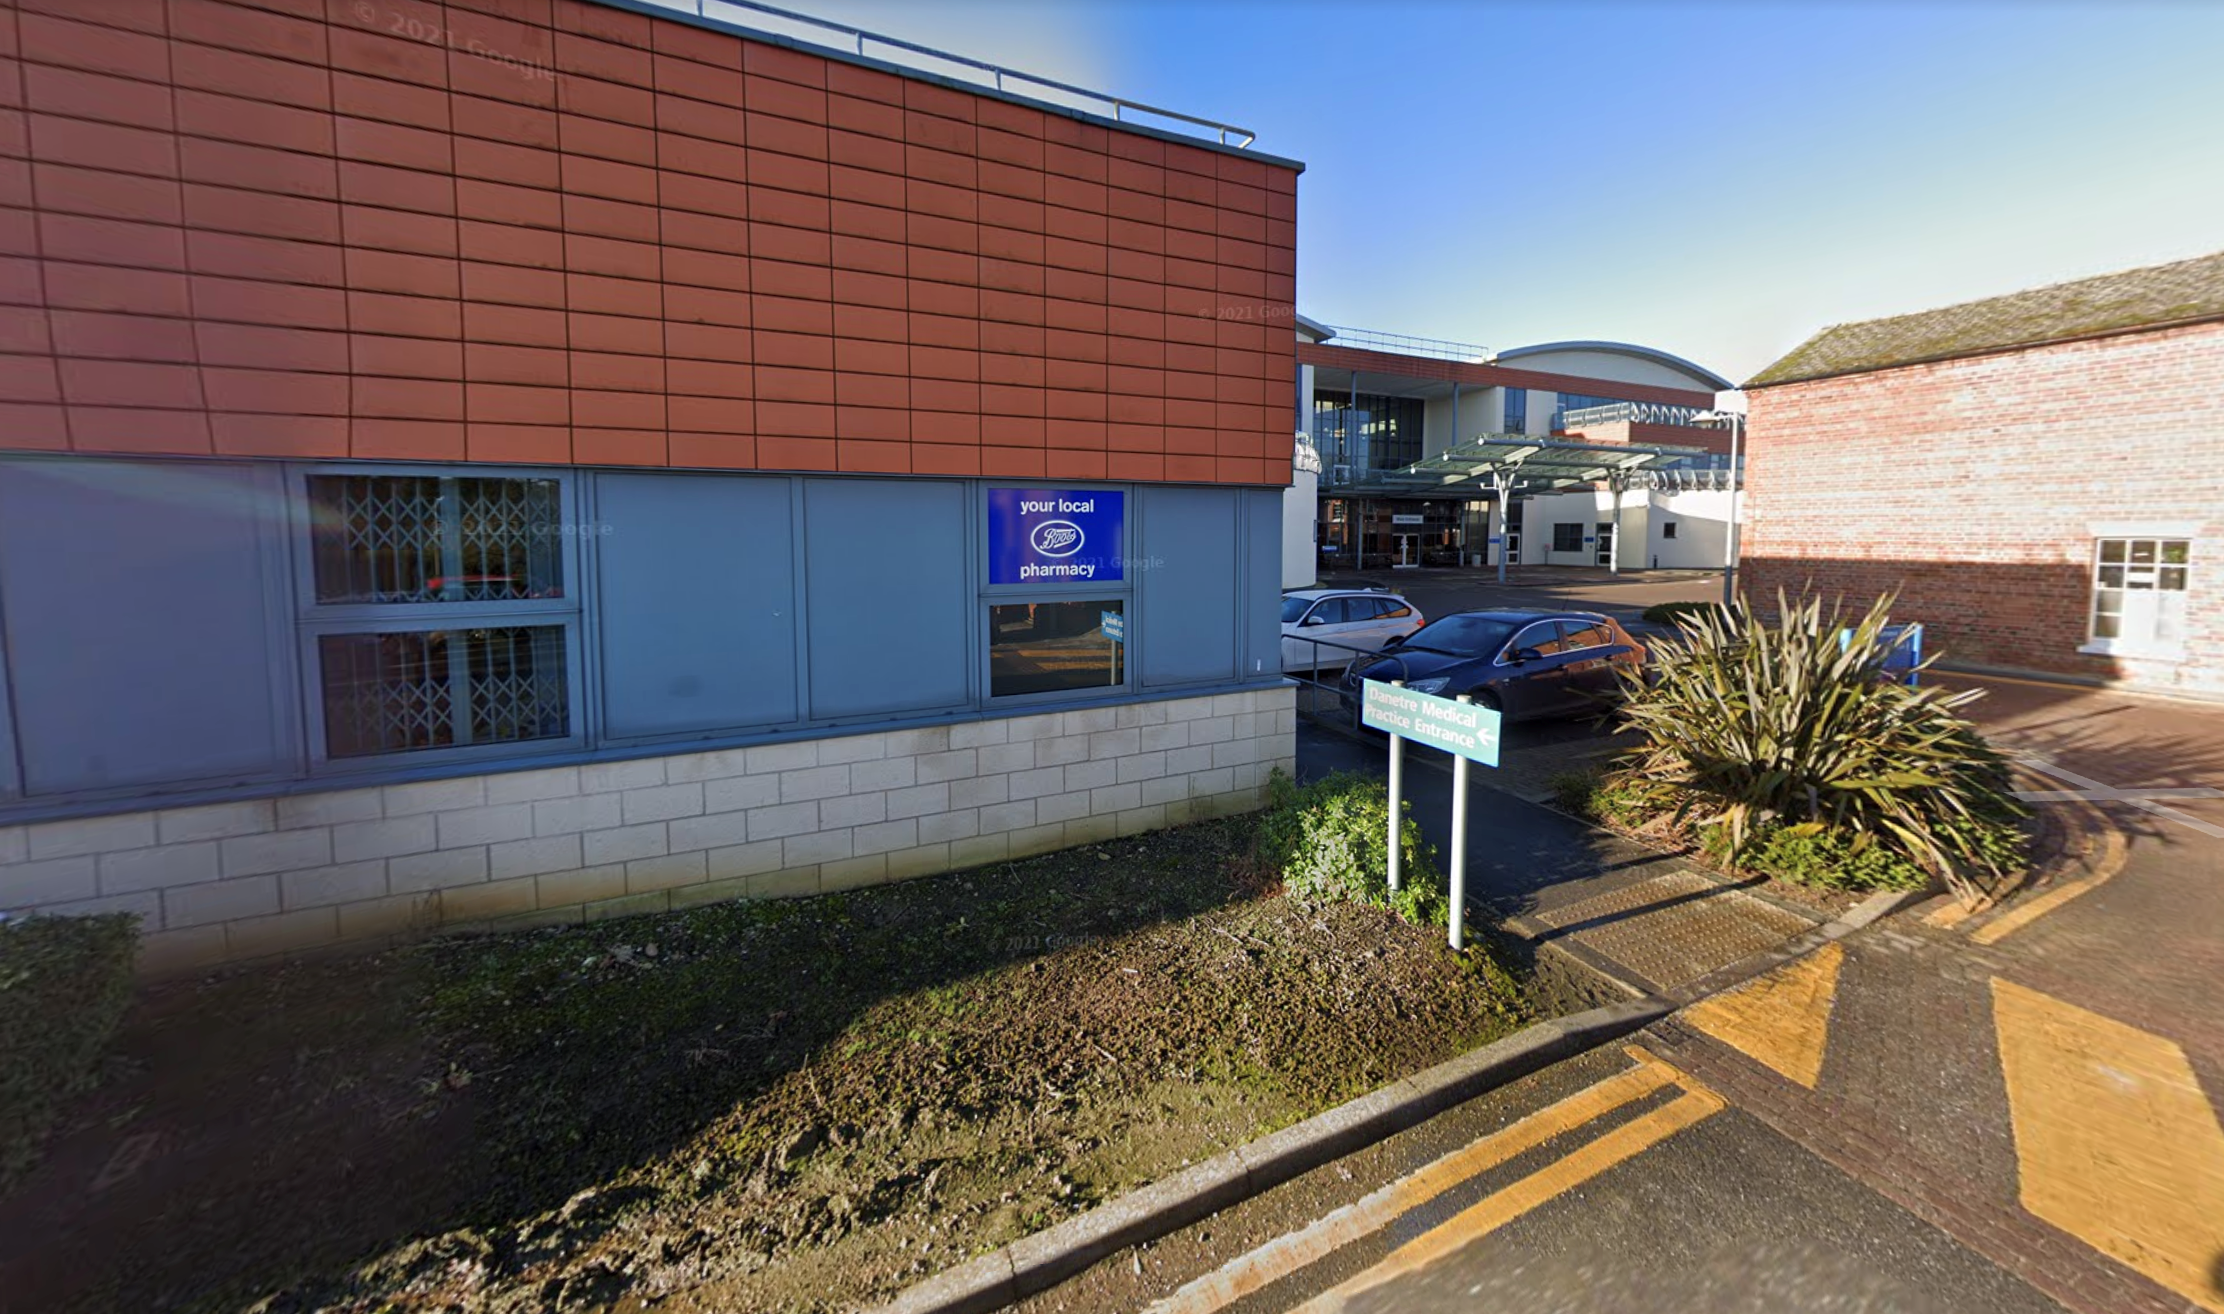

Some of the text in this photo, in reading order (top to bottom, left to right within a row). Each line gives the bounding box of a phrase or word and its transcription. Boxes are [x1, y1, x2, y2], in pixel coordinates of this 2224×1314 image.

[1020, 498, 1094, 515] your local
[1039, 527, 1077, 549] Boots
[1020, 563, 1095, 579] pharmacy
[1369, 686, 1477, 728] Danetre Medical
[1365, 702, 1476, 749] Practice Entrance
